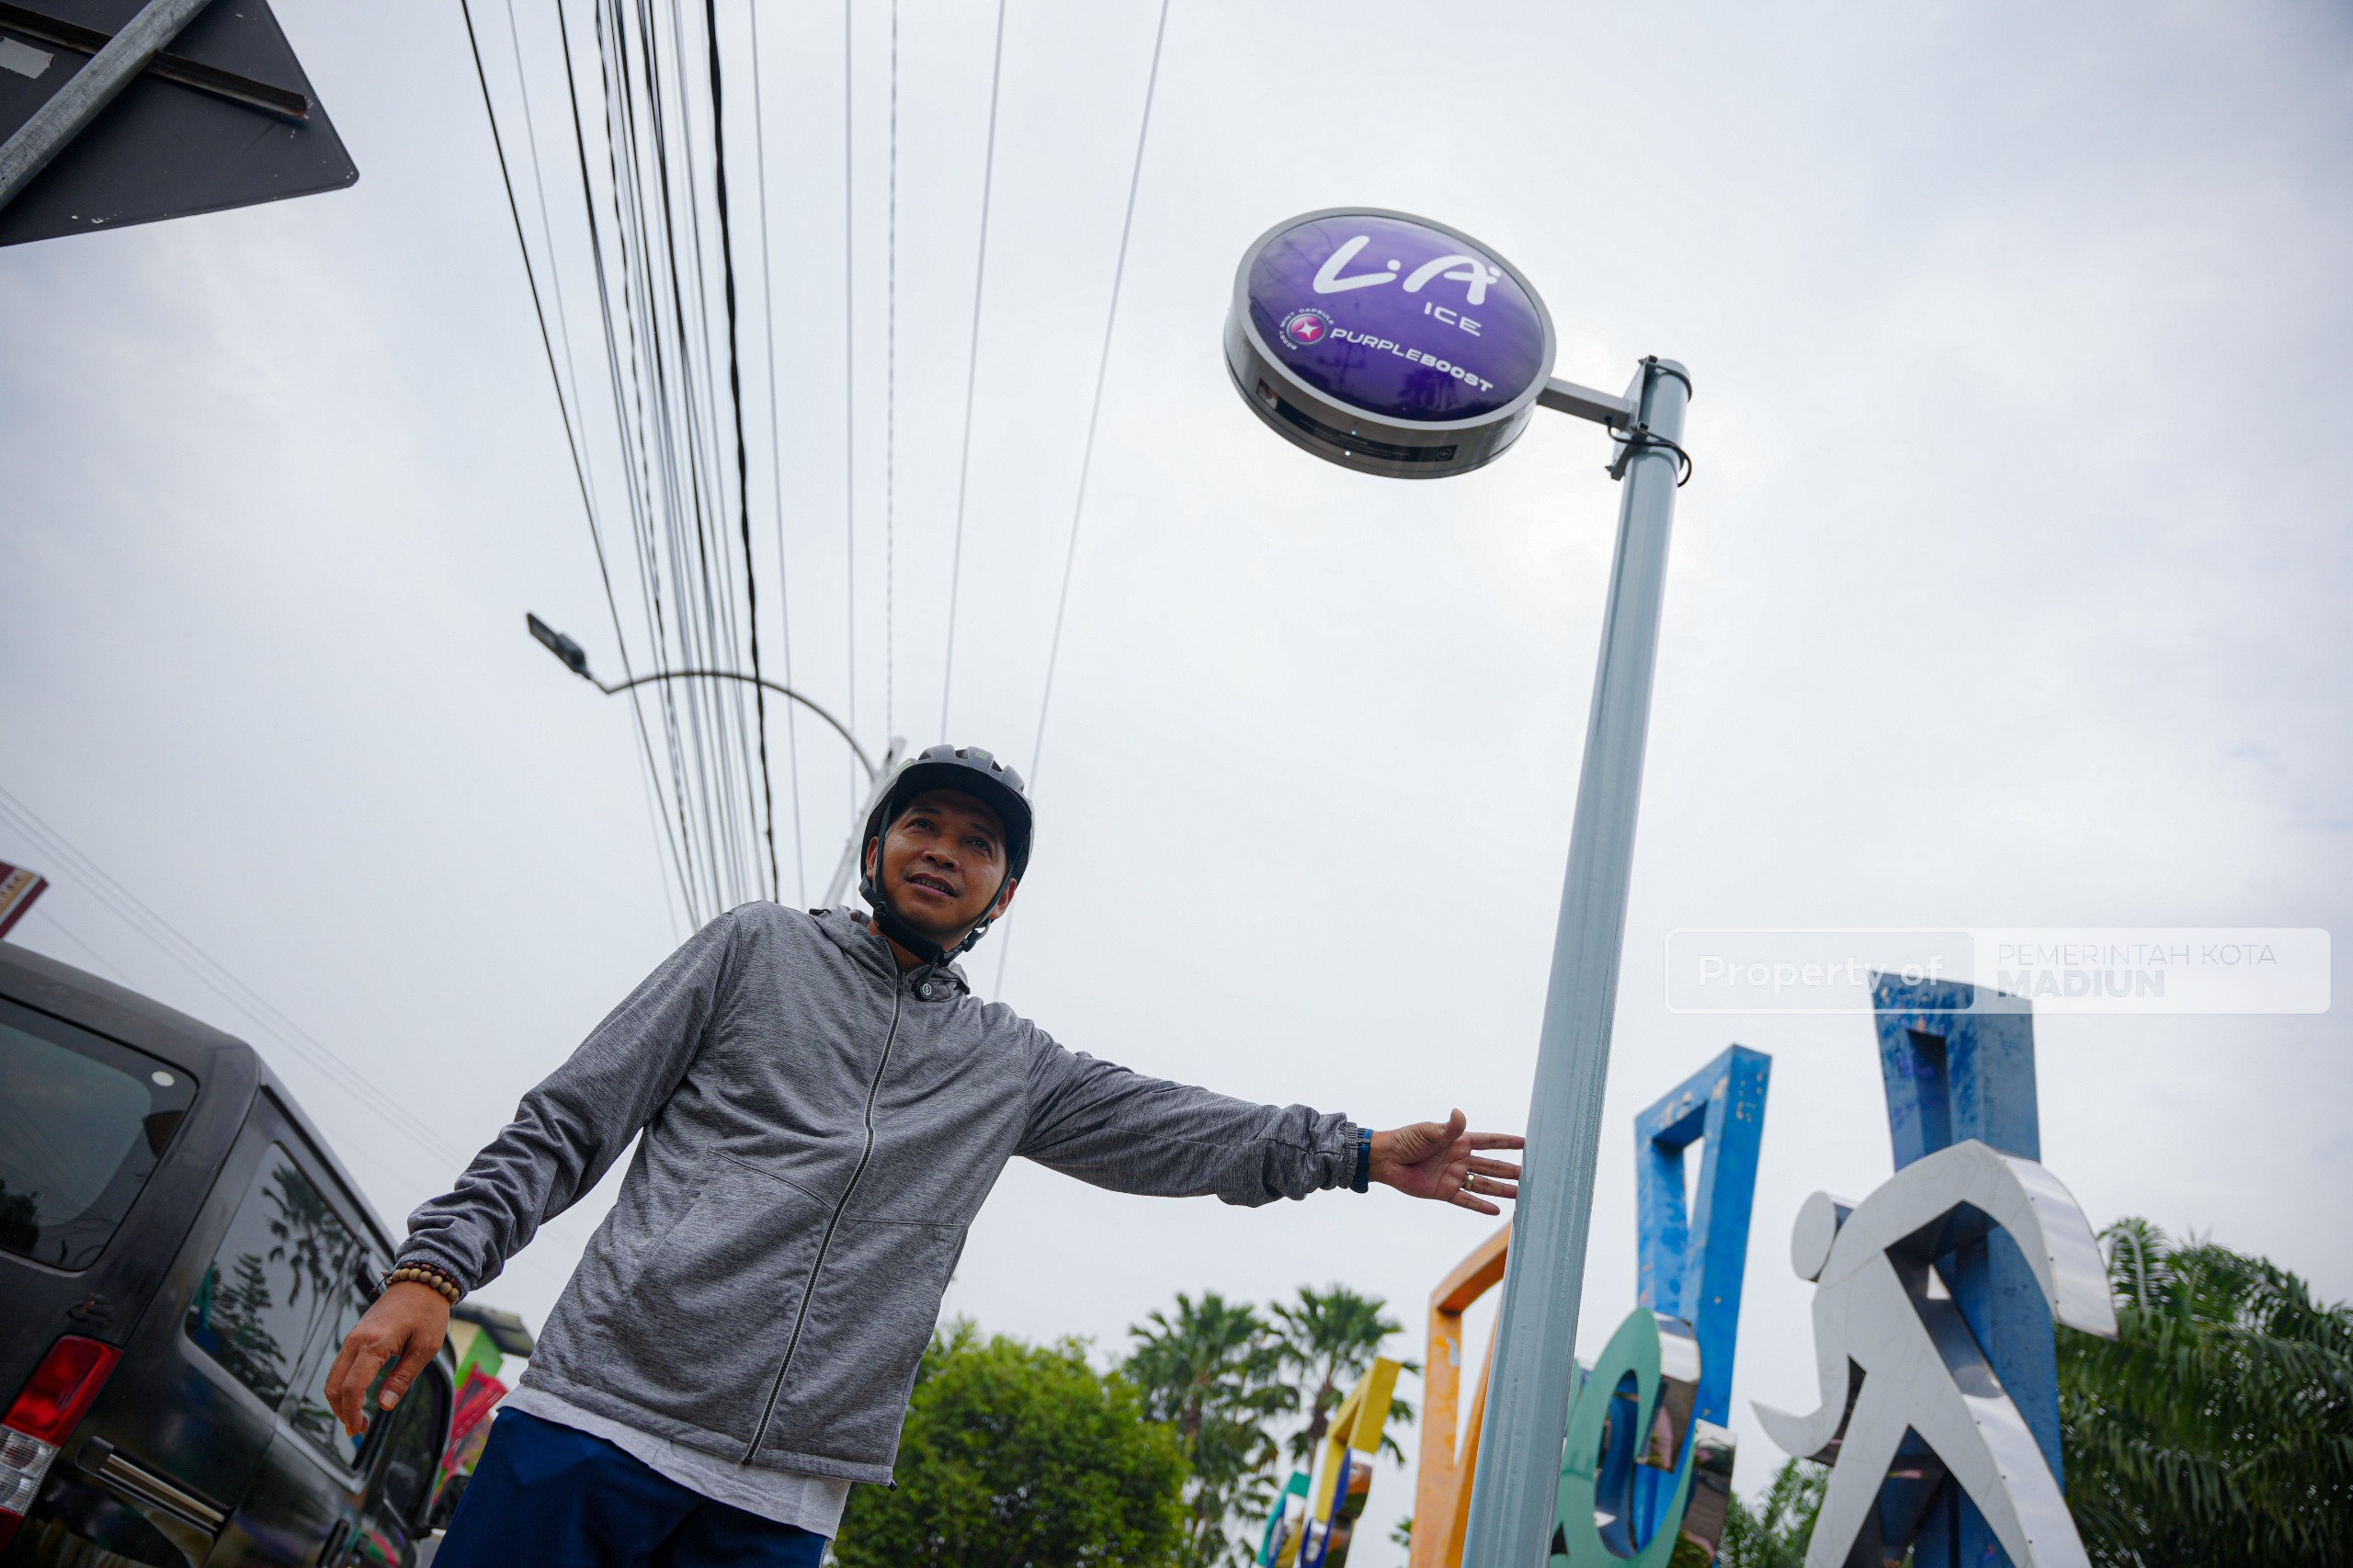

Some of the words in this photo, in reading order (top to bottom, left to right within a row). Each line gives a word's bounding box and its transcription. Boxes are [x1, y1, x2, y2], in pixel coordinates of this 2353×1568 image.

[1279, 311, 1295, 328] MINT
[1298, 307, 1335, 325] CAPSULE
[1424, 301, 1483, 337] ICE
[1279, 330, 1298, 350] BERRY
[1329, 327, 1495, 392] PURPLEBOOST
